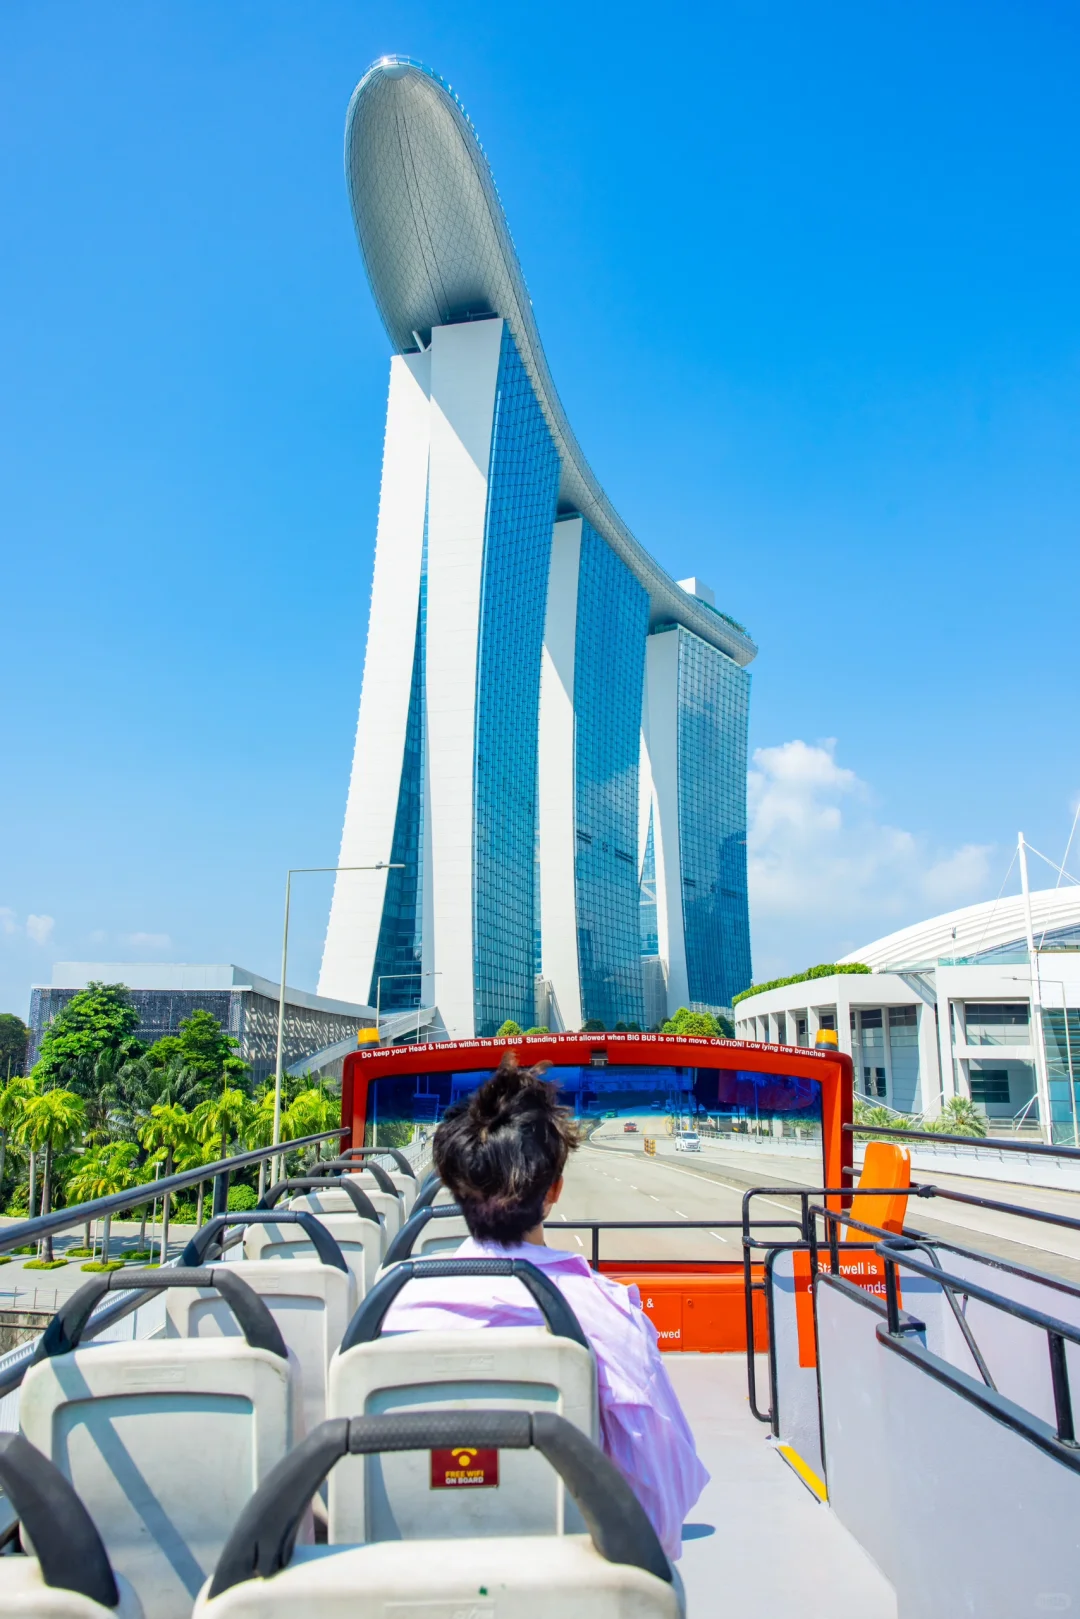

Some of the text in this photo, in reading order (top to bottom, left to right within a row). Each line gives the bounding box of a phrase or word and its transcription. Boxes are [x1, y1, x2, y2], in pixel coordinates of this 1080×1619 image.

[711, 1038, 744, 1048] CAUTION!
[762, 1044, 778, 1052] lying
[794, 1048, 825, 1058] branches
[818, 1262, 878, 1274] Starwell is
[646, 1298, 654, 1308] &
